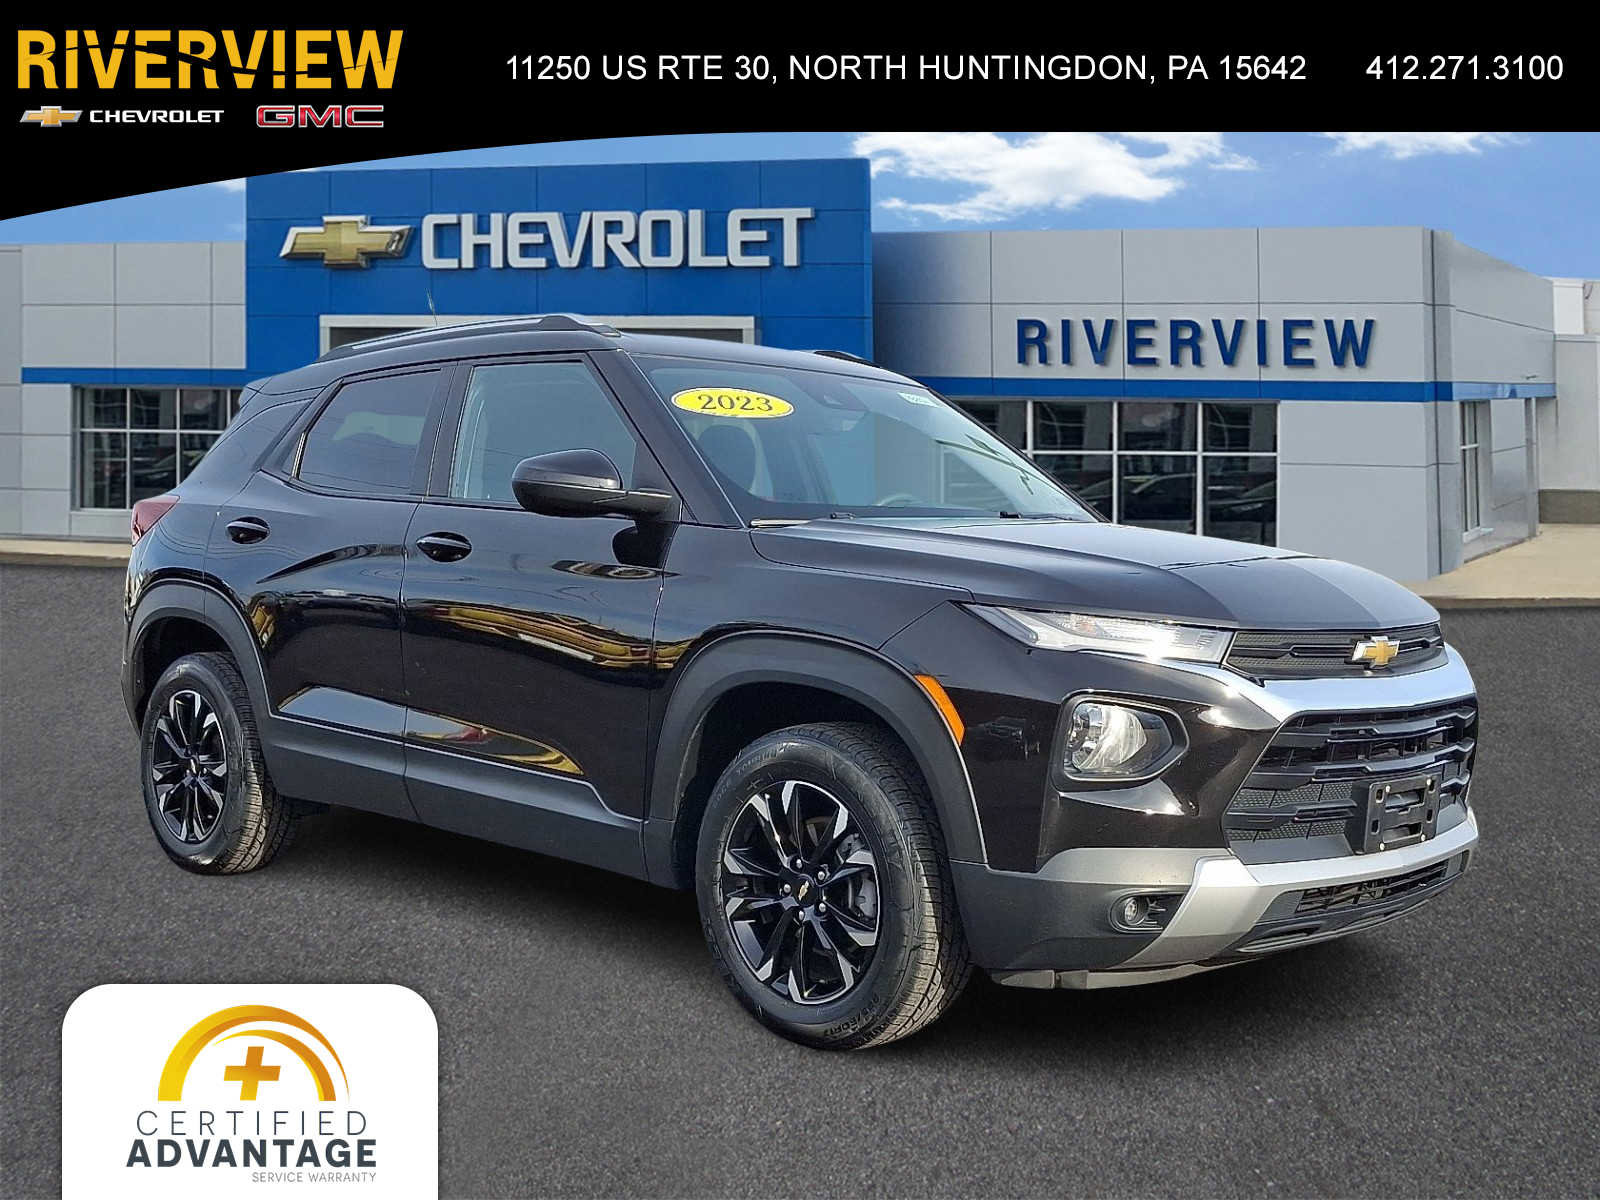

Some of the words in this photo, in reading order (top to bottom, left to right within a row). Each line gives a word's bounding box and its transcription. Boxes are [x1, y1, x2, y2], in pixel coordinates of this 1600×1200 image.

[421, 207, 813, 270] CHEVROLET
[1016, 318, 1376, 369] RIVERVIEW
[697, 394, 774, 412] 2023
